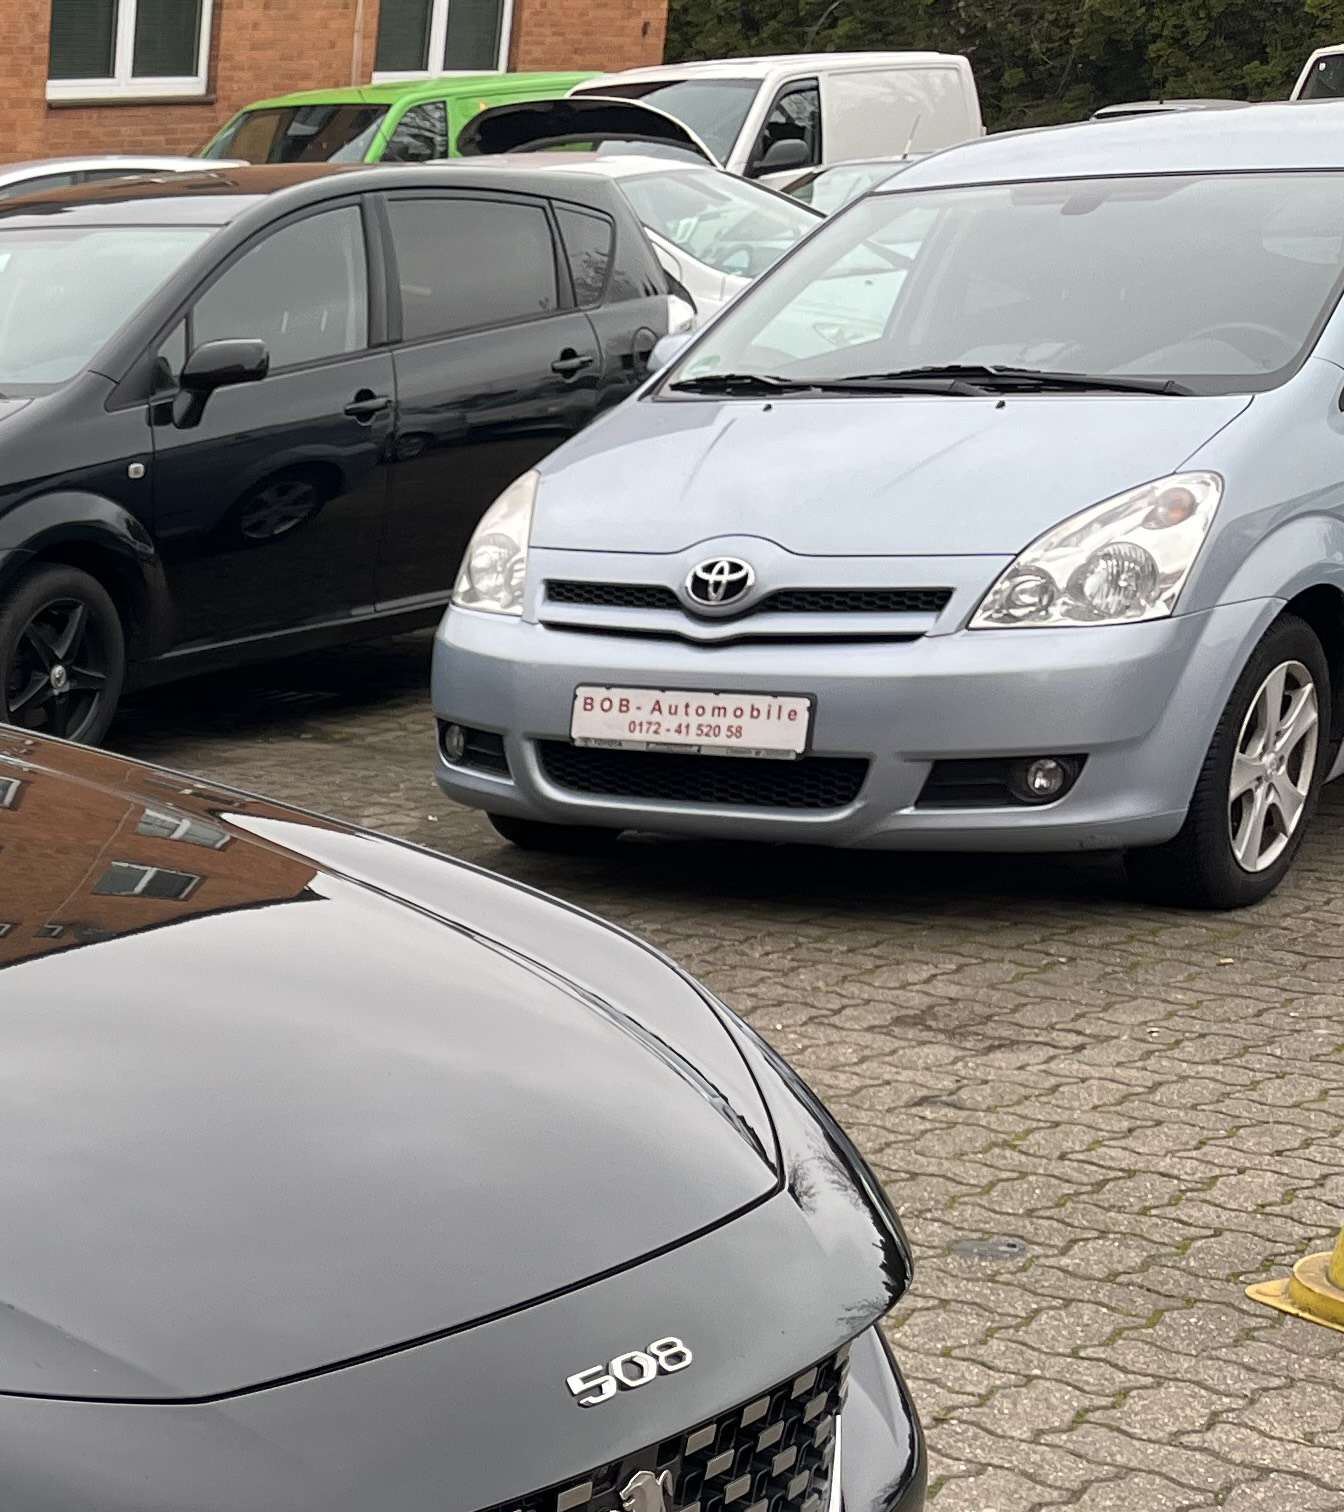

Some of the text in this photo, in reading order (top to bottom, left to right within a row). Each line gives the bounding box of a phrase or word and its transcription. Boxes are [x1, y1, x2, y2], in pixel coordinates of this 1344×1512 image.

[627, 719, 662, 735] 0172
[673, 722, 691, 737] 41
[695, 723, 722, 738] 520
[725, 724, 744, 739] 58
[565, 1335, 694, 1409] 508
